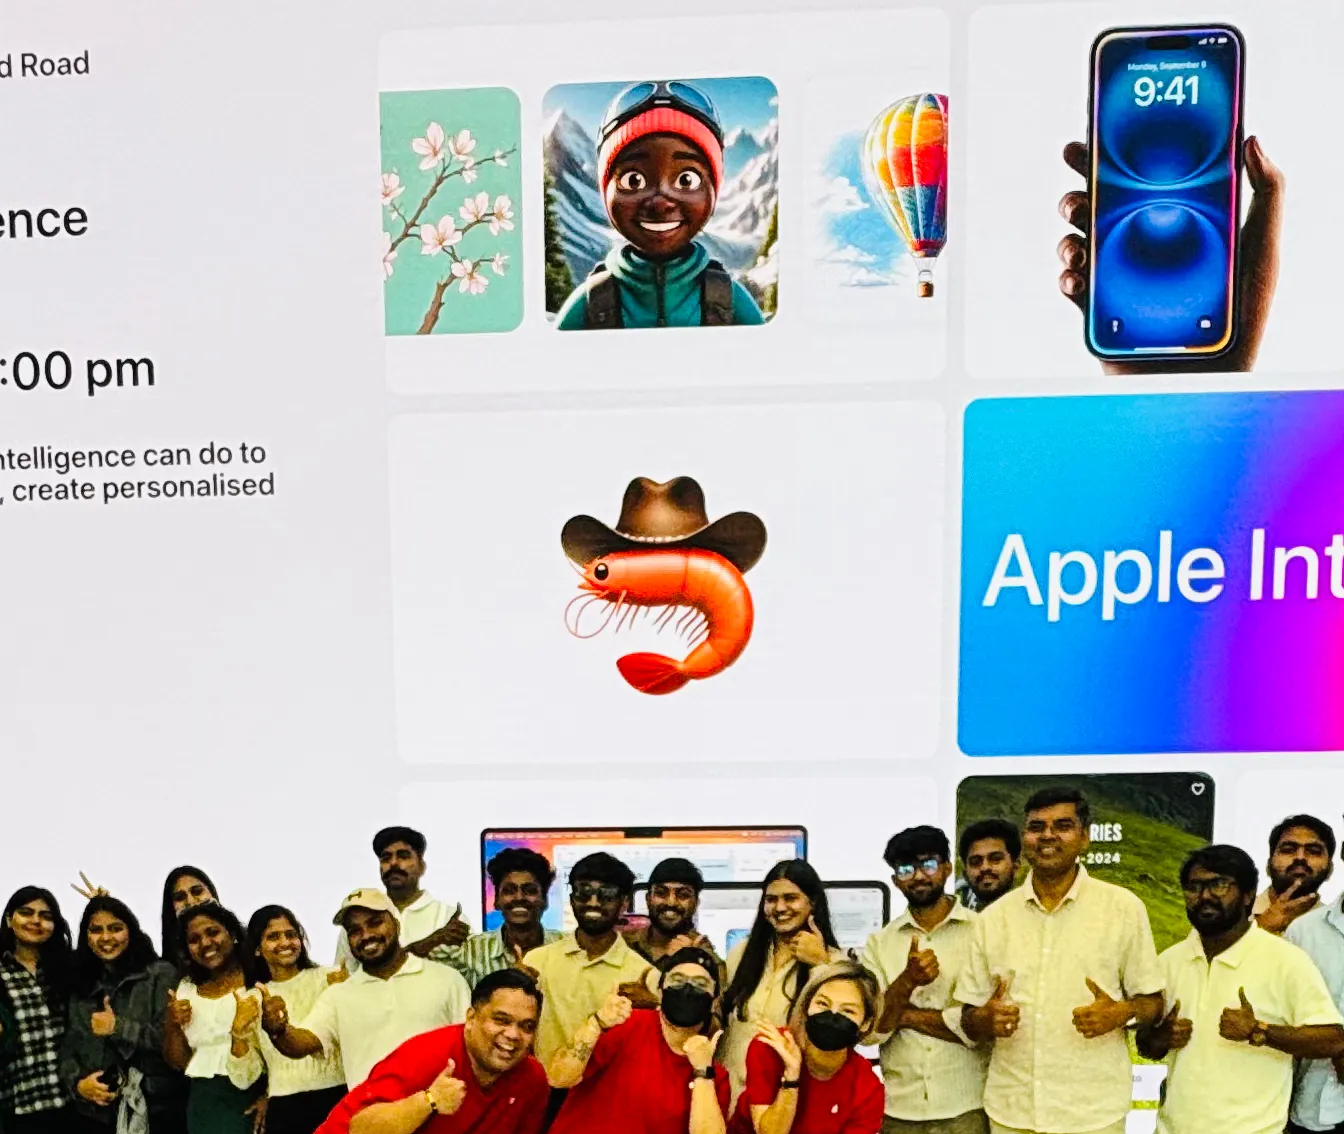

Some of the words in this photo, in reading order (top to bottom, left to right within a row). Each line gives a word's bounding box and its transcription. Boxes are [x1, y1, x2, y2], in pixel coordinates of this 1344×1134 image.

[20, 49, 90, 78] Road
[1134, 75, 1199, 107] 9:41
[86, 357, 155, 398] pm
[143, 447, 192, 467] can
[198, 440, 233, 466] do
[238, 441, 267, 464] to
[12, 478, 96, 502] create
[102, 471, 275, 505] personalised
[982, 530, 1225, 622] Apple
[1089, 822, 1123, 842] RIES
